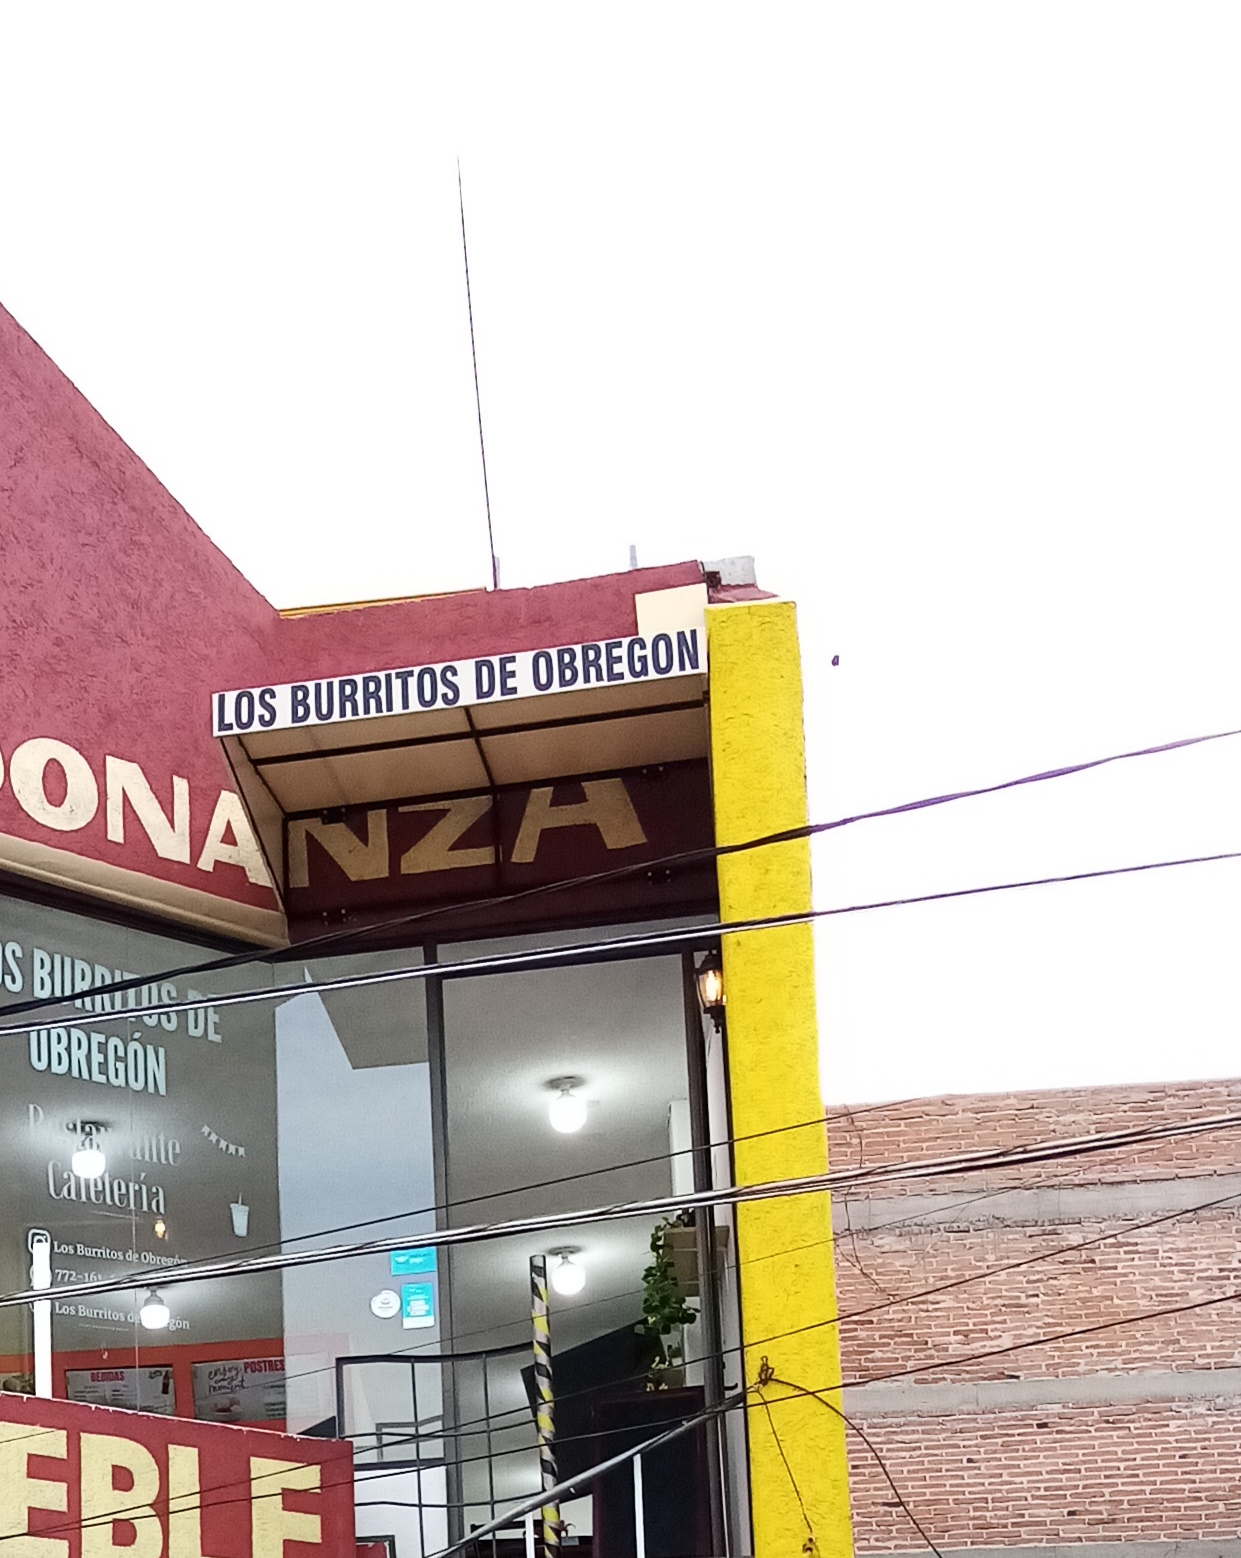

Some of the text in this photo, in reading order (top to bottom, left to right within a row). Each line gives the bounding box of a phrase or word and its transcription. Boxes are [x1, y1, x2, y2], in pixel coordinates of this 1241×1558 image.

[217, 627, 701, 731] LOS BURRITOS DE OBREGON
[32, 946, 178, 1032] BURRITOS
[187, 991, 223, 1043] DE
[28, 1029, 167, 1097] OBREGÓN
[53, 1240, 74, 1254] Los
[77, 1243, 123, 1262] Burritos
[125, 1250, 139, 1263] de
[55, 1302, 76, 1316] Los
[78, 1306, 125, 1322] Burritos
[243, 1359, 285, 1374] POSTRES
